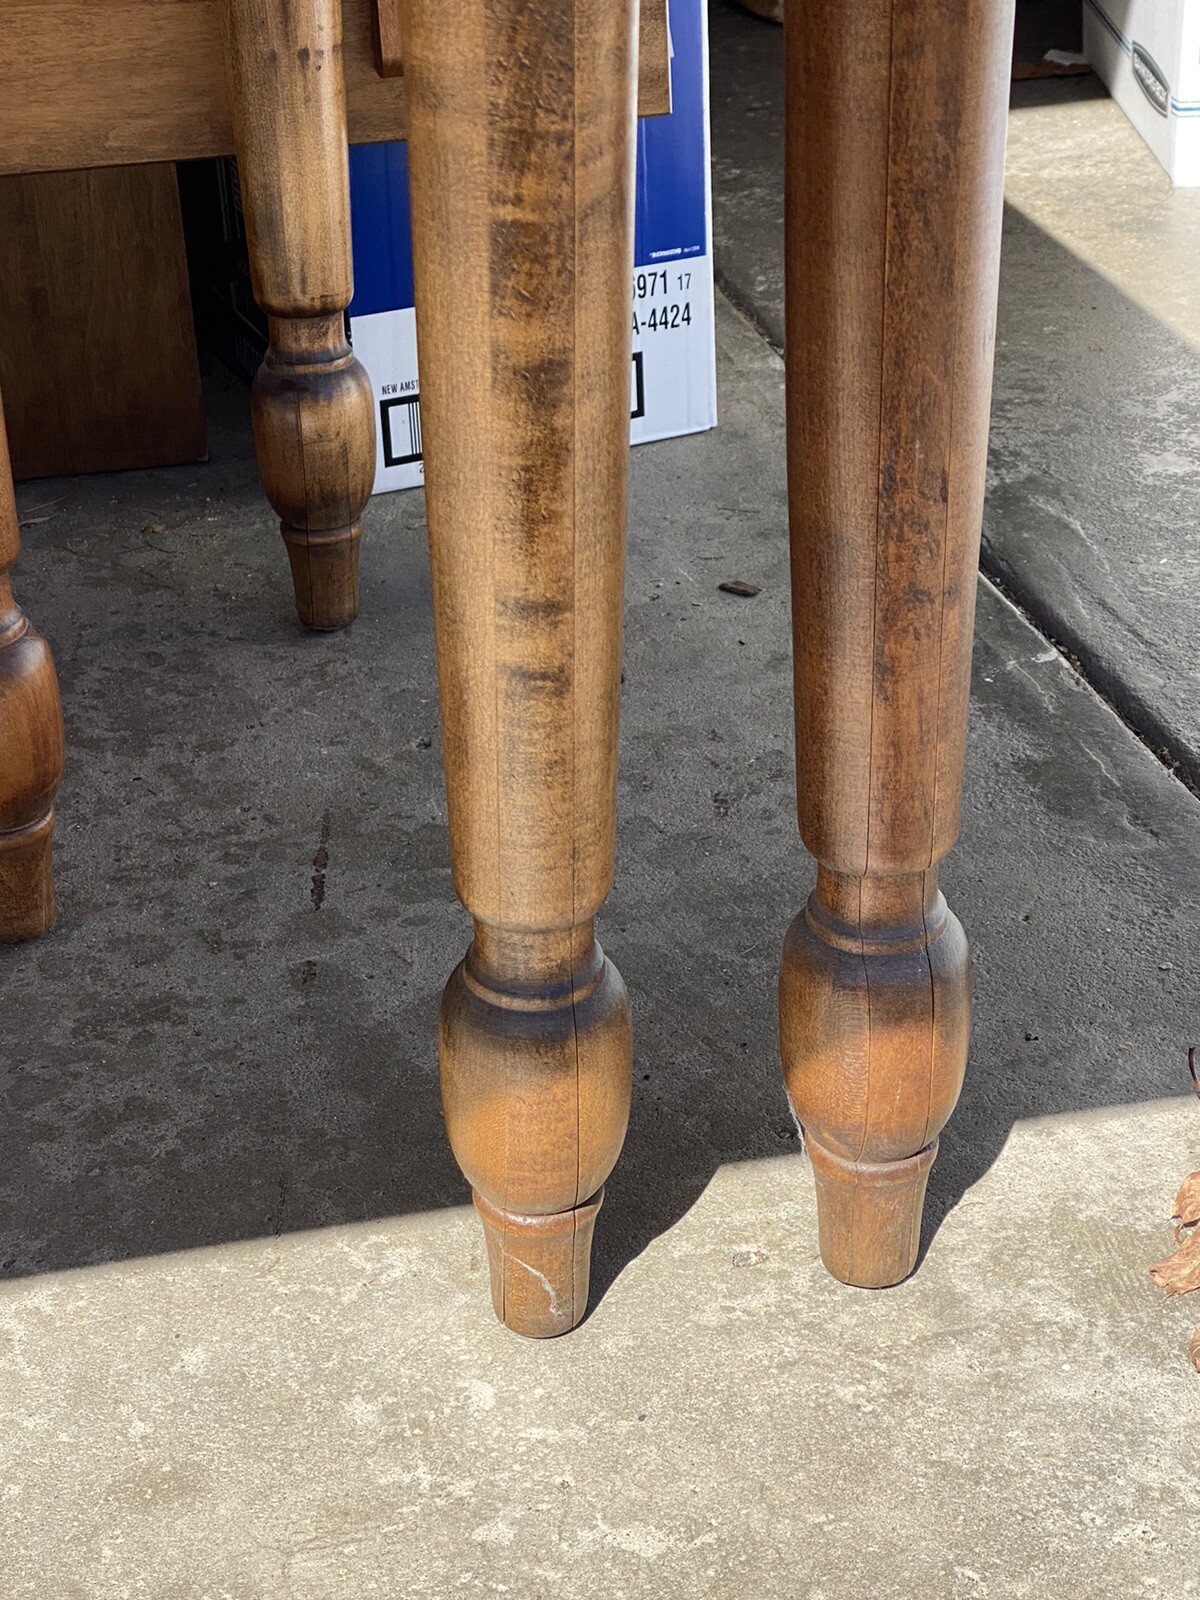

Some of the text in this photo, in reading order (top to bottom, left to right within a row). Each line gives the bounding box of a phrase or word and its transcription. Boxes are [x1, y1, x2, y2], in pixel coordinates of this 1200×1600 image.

[633, 270, 692, 300] 971 17
[381, 383, 398, 395] NEW
